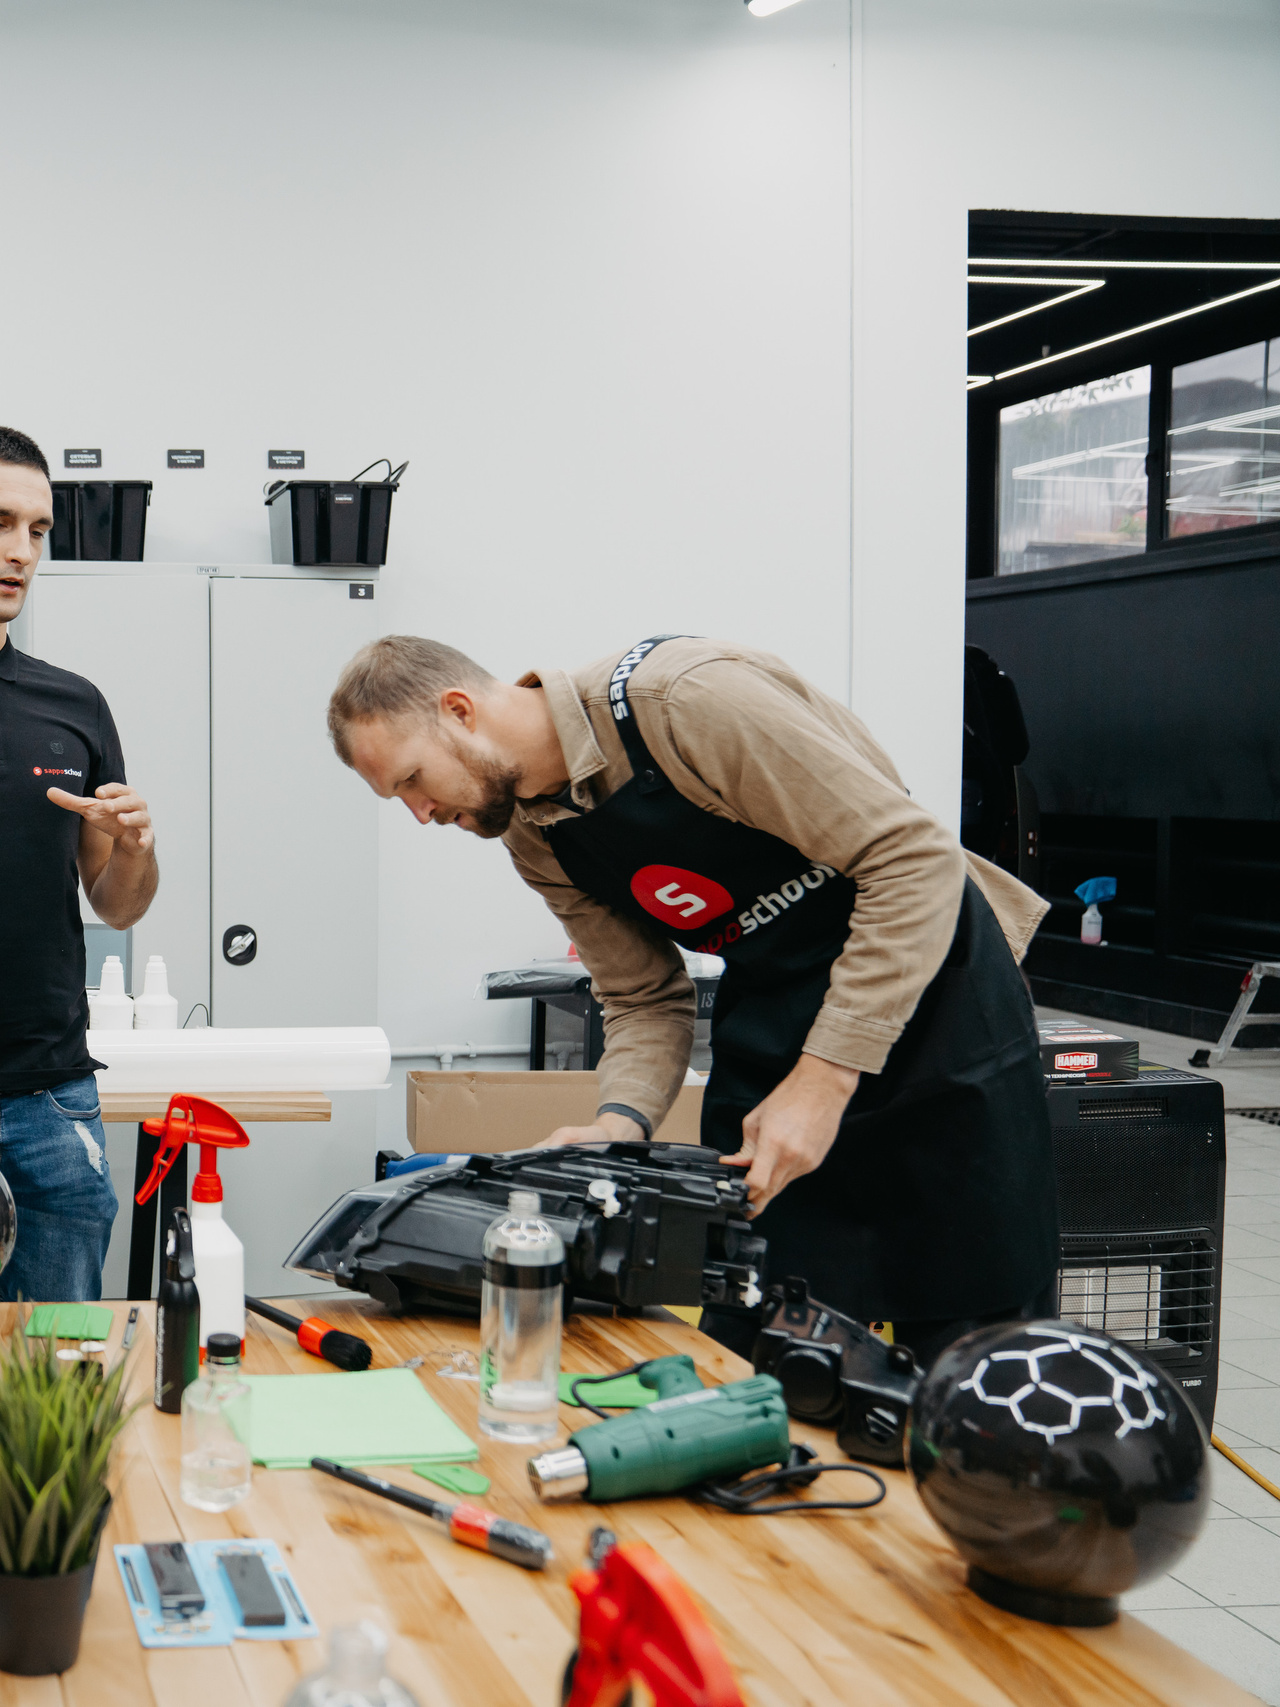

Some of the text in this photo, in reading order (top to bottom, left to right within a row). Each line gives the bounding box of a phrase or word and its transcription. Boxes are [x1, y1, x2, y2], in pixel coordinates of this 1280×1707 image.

[357, 588, 366, 597] 3
[609, 642, 655, 721] sappo
[43, 768, 82, 777] sapposchool
[1057, 1055, 1095, 1067] HAMMER
[1182, 1379, 1202, 1387] TURBO
